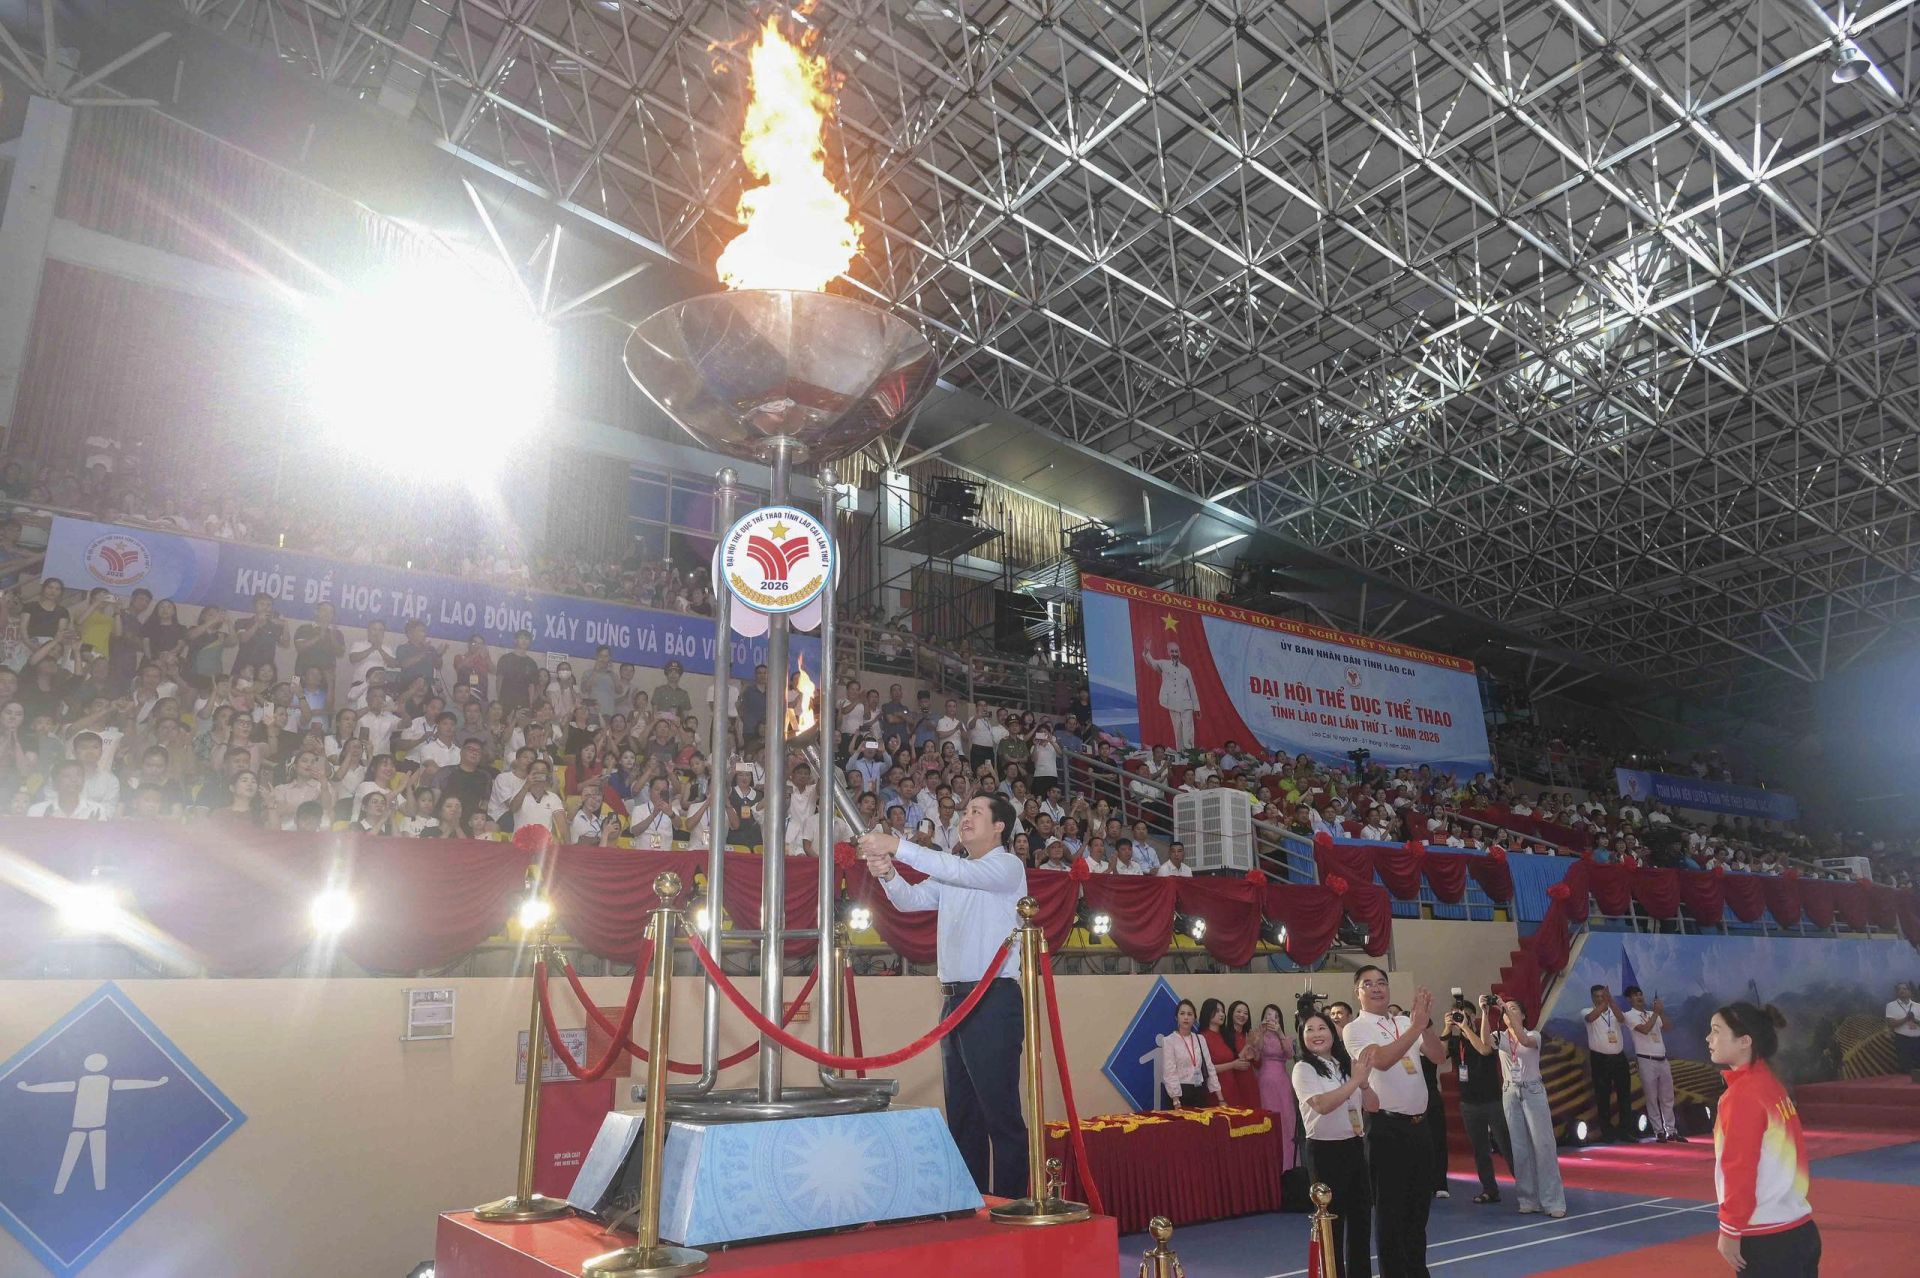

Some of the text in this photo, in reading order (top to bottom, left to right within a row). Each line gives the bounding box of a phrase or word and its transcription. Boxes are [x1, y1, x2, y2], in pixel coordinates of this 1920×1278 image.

[740, 522, 752, 533] DỤC
[784, 510, 798, 522] TỈNH
[810, 526, 821, 536] CAI
[760, 582, 788, 590] 2026
[235, 564, 297, 601] KHỎE
[304, 570, 334, 604] ĐỂ
[341, 586, 383, 620] HỌC
[392, 586, 431, 627] TẬP,
[440, 604, 476, 628] LAO
[484, 604, 538, 640] ĐỘNG,
[544, 610, 578, 642] XÂY
[586, 617, 630, 650] DỰNG
[637, 622, 658, 654] VÀ
[664, 625, 696, 658] BẢO
[1105, 582, 1460, 668] NƯỚC CỘNG HÒA XÃ HỘI CHỦ NGHĨA VIỆT NAM MUÔN NĂM
[1280, 639, 1416, 677] ỦY BAN NHÂN DÂN TỈNH LÀO CAI
[1250, 676, 1452, 728] ĐẠI HỘI THỂ DỤC THỂ THAO
[1270, 702, 1296, 722] TỈNH
[1298, 706, 1318, 724] LÀO
[1320, 713, 1337, 727] CAI
[1340, 712, 1358, 730] LẦN
[1361, 717, 1379, 734] THỨ
[1381, 723, 1388, 735] I
[1396, 725, 1416, 741] NĂM
[1418, 729, 1440, 744] 2026
